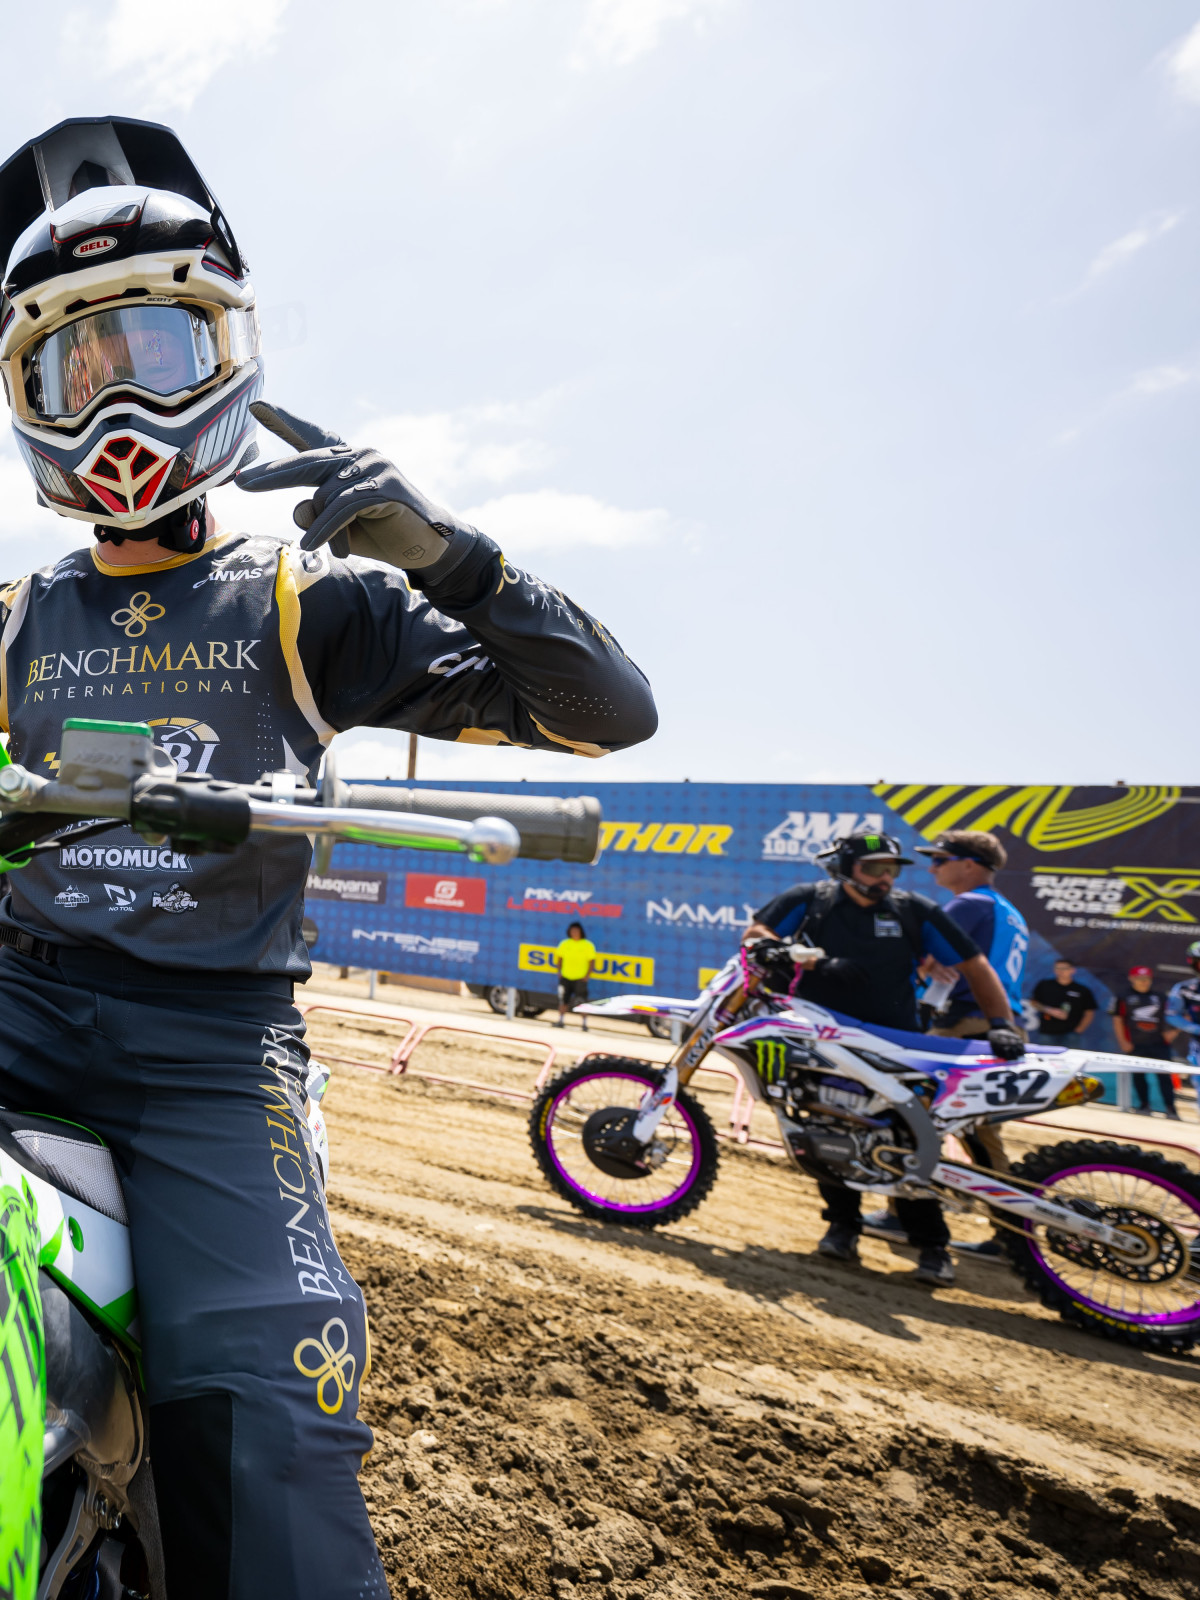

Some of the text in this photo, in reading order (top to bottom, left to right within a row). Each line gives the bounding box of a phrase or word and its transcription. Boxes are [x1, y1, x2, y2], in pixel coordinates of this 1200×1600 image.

[80, 240, 110, 253] BELL
[26, 639, 262, 688] BENCHMARK
[23, 680, 251, 705] INTERNATIONAL
[762, 811, 883, 840] AMA
[599, 821, 734, 855] THOR
[763, 839, 800, 855] 100
[61, 847, 188, 870] MOTOMUCK
[307, 872, 380, 894] Husqvarna
[1031, 874, 1126, 892] SUPER
[1035, 887, 1123, 903] MOTO
[352, 929, 480, 952] INTENSE
[527, 951, 643, 979] SUUKI
[984, 1068, 1051, 1106] 32
[259, 1025, 342, 1305] BENCHMARK
